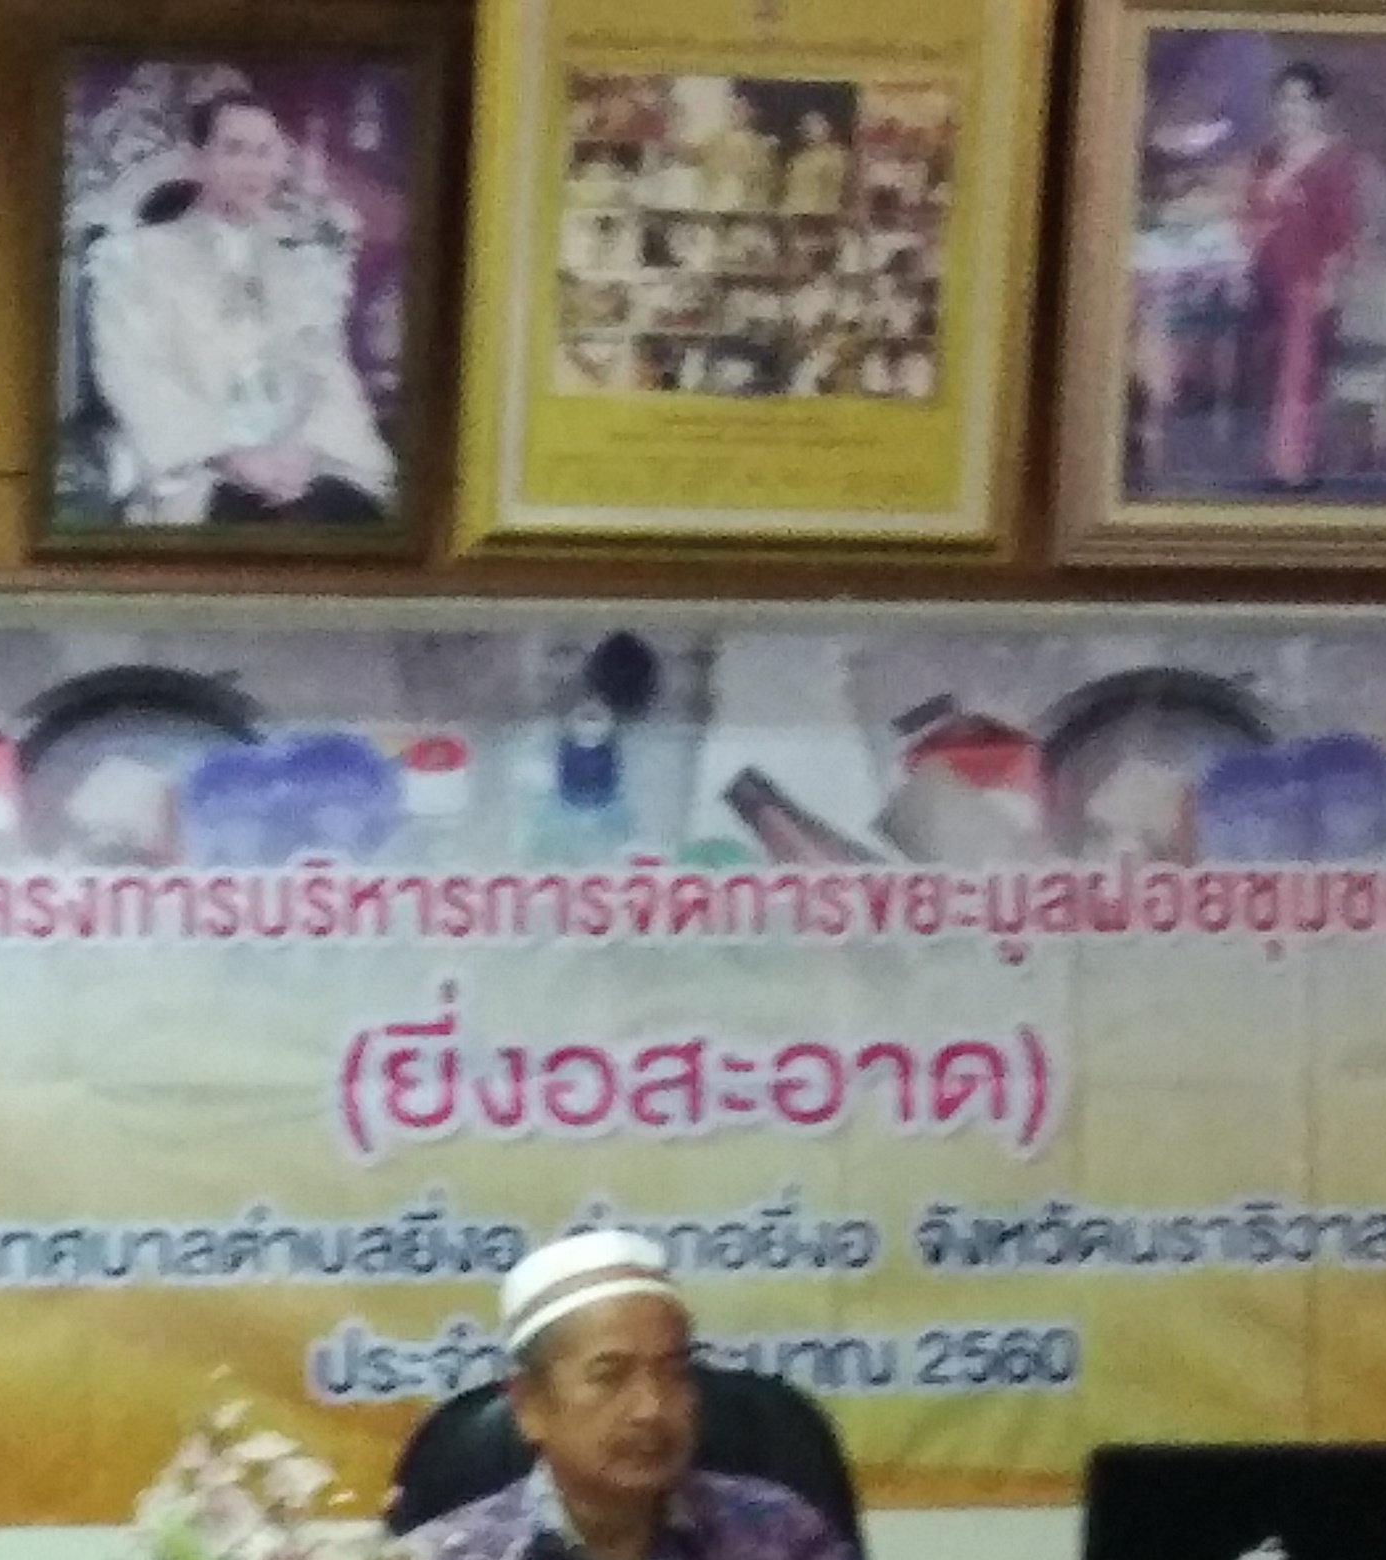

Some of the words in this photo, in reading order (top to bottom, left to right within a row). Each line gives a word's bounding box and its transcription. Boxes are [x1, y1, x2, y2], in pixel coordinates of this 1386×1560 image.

[342, 978, 1051, 1153] (ยี่งอสะอาด)
[917, 1328, 1079, 1385] 2560
